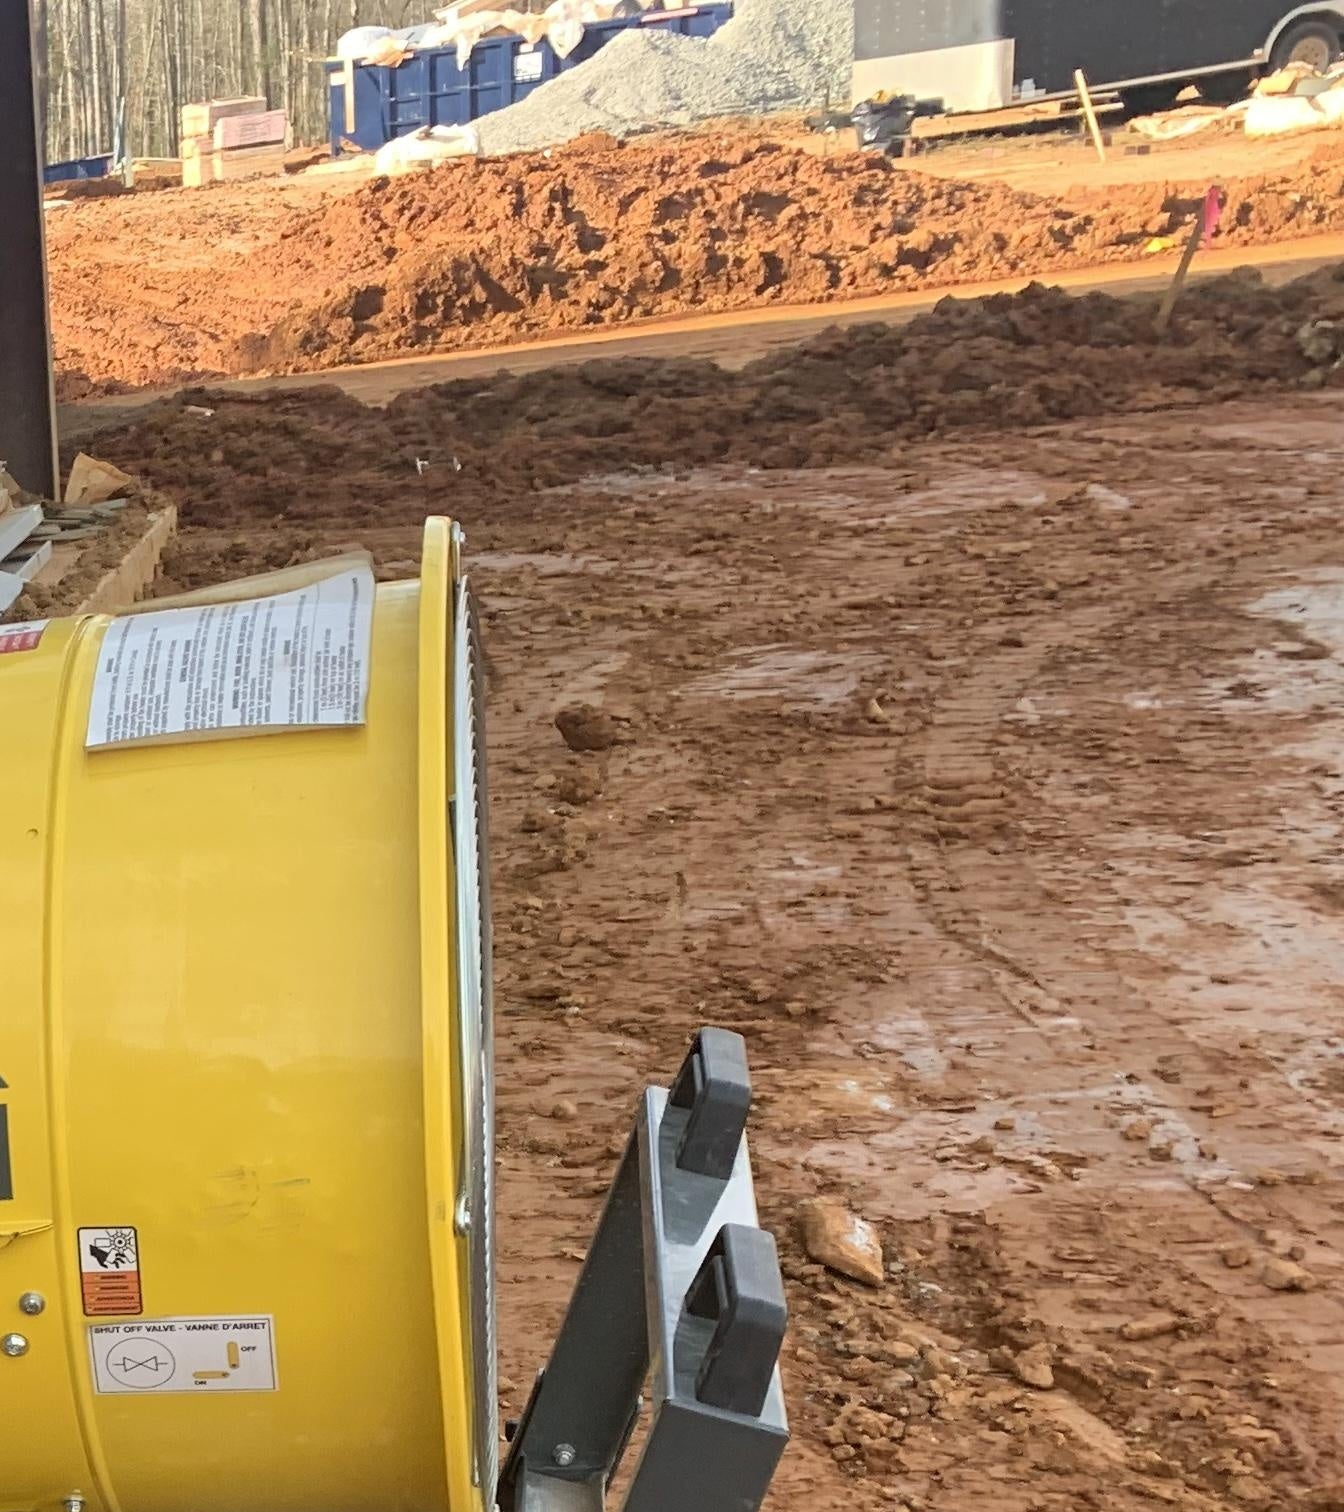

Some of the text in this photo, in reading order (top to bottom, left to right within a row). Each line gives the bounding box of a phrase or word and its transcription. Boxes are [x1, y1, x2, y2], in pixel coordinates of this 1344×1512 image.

[94, 1326, 120, 1334] SHUT
[123, 1326, 143, 1334] OFF
[145, 1324, 176, 1332] VALVE
[186, 1323, 220, 1331] VANNE
